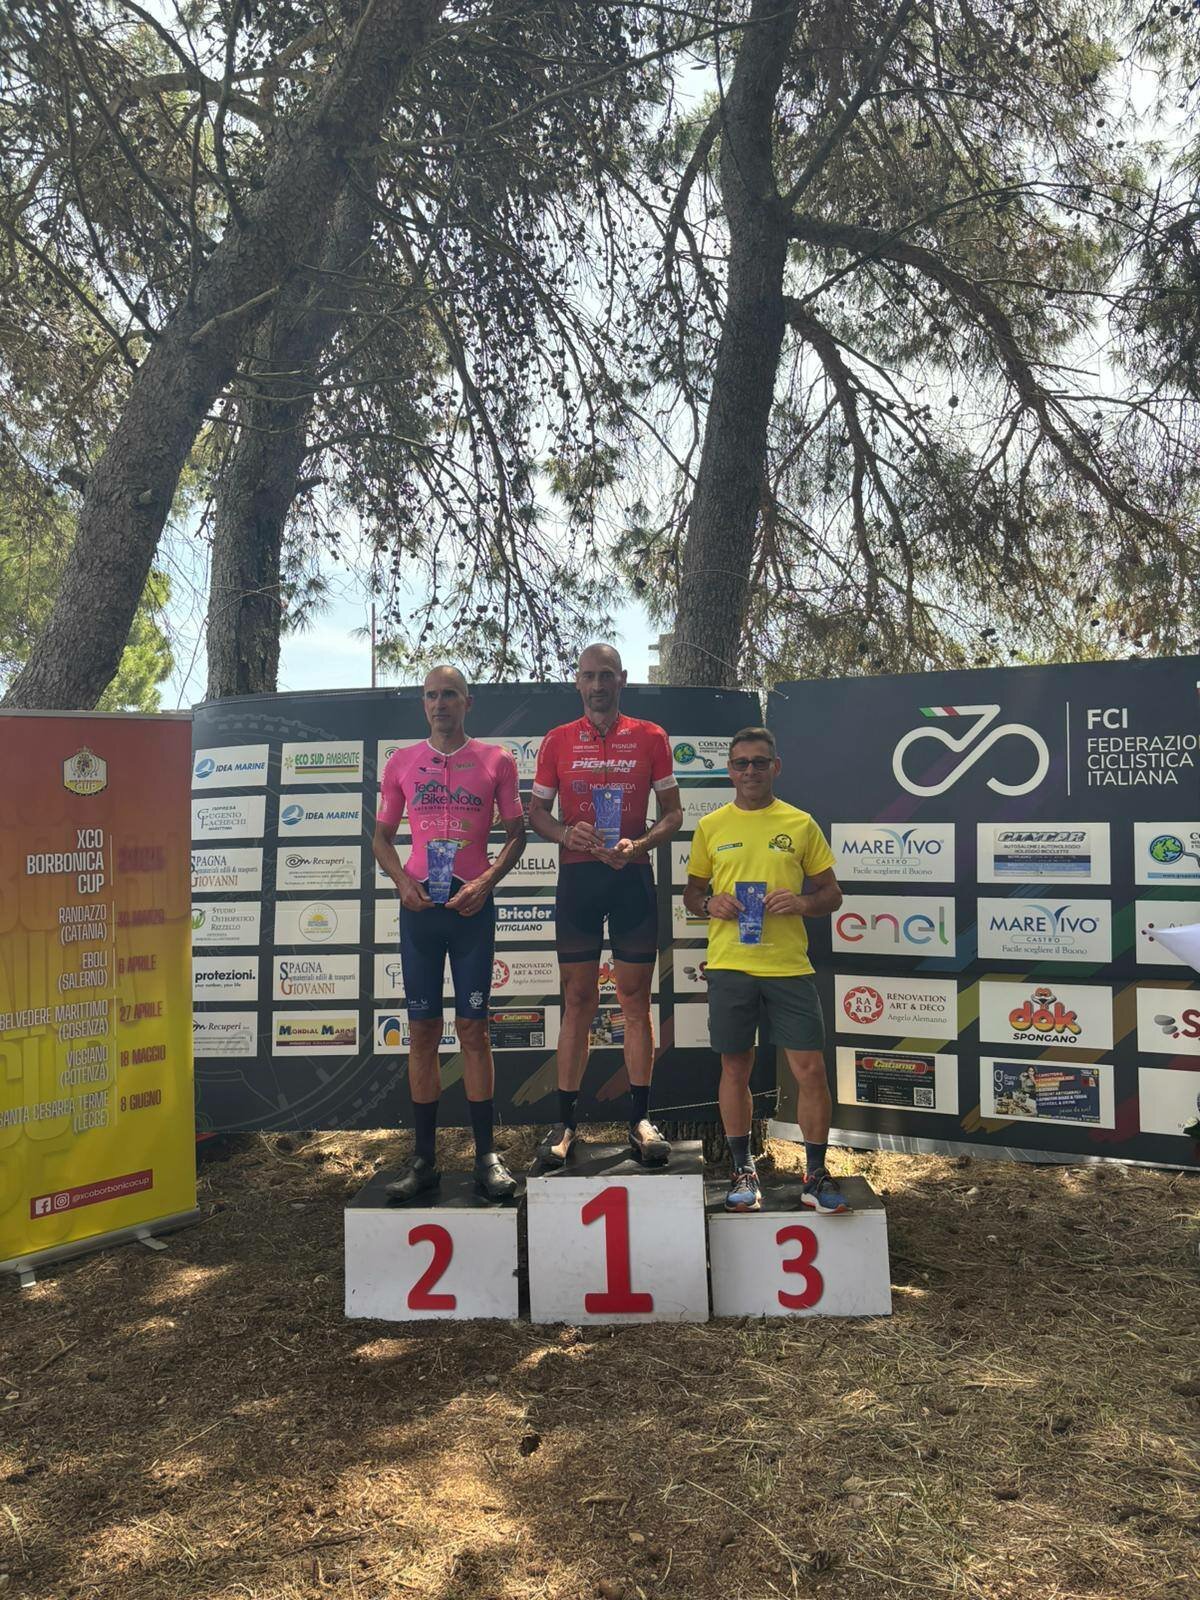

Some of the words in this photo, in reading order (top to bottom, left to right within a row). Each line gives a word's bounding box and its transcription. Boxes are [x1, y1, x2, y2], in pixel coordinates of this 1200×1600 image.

[1087, 708, 1128, 729] FCI
[234, 762, 266, 771] MARINE
[295, 754, 309, 765] ECO
[310, 753, 324, 764] SUD
[325, 752, 360, 764] AMBIENTE
[1087, 752, 1194, 769] CICLISTICA
[414, 782, 449, 793] Team
[1088, 770, 1179, 786] ITALIANA
[305, 812, 324, 820] IDEA
[325, 811, 359, 819] MARINE
[77, 829, 104, 848] XCO
[997, 831, 1087, 843] CITYCAR
[26, 852, 105, 875] BORBONICA
[312, 857, 345, 867] Recuperi
[77, 874, 105, 894] CUP
[58, 904, 108, 925] RANDAZZO
[498, 907, 552, 920] Bricofer
[60, 922, 108, 945] (CATANIA)
[496, 924, 543, 932] VITIGLIANO
[836, 906, 949, 945] enel
[1002, 945, 1023, 953] Facile
[1024, 945, 1053, 954] scegliere
[1055, 945, 1061, 954] il
[1062, 946, 1088, 954] Buono
[82, 950, 108, 970] EBOLI
[195, 969, 256, 983] protezioni.
[280, 962, 323, 979] SPAGNA
[58, 968, 109, 994] (SALERNO)
[280, 977, 336, 995] GIOVANNI
[886, 993, 947, 1003] RENOVATION
[889, 1002, 907, 1010] ART
[0, 1006, 52, 1031] BELVEDERE
[54, 999, 109, 1022] MARITTIMO
[119, 1006, 132, 1024] 27
[133, 1000, 164, 1019] APRILE
[1008, 1000, 1082, 1035] dok
[58, 1018, 109, 1044] (COSENZA)
[208, 1022, 242, 1032] Recuperi
[279, 1025, 319, 1036] MONDIAL
[1012, 1032, 1077, 1044] SPONGANO
[66, 1045, 109, 1067] VIGGIANO
[120, 1050, 130, 1067] 18
[132, 1044, 167, 1066] MAGGIO
[59, 1064, 109, 1089] (POTENZA)
[78, 1089, 109, 1112] TERME
[120, 1096, 127, 1112] 8
[129, 1089, 162, 1111] GIUGNO
[73, 1110, 110, 1135] (LECCE)
[581, 1186, 654, 1314] 1
[407, 1224, 457, 1311] 2
[775, 1224, 825, 1310] 3
